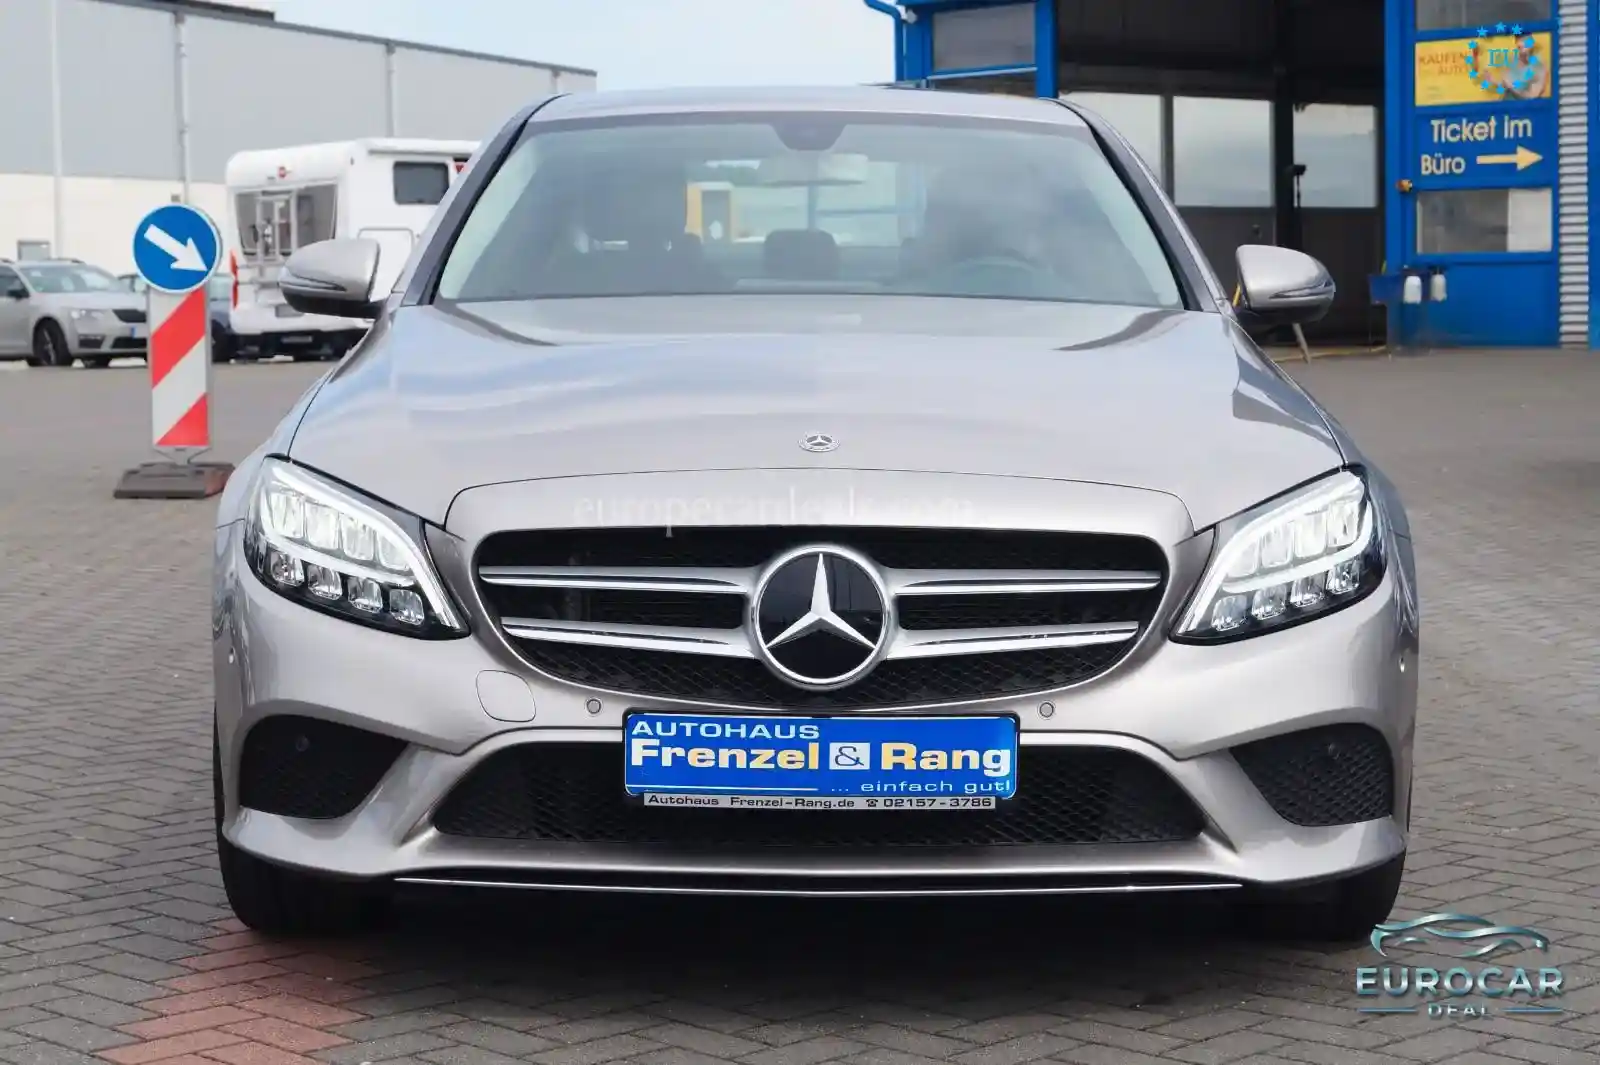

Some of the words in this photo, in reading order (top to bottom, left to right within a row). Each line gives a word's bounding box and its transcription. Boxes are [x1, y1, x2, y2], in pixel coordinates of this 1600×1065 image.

[1430, 115, 1496, 142] Ticket
[1421, 152, 1466, 175] Büro
[631, 721, 820, 739] AUTOHAUS
[631, 738, 819, 770] Frenzel
[834, 745, 865, 767] &
[881, 742, 1011, 777] Rang
[860, 780, 953, 792] einfach
[648, 795, 719, 806] Autohaus
[730, 797, 855, 809] Frenzel-Rang.de
[883, 798, 992, 808] 02157-3786
